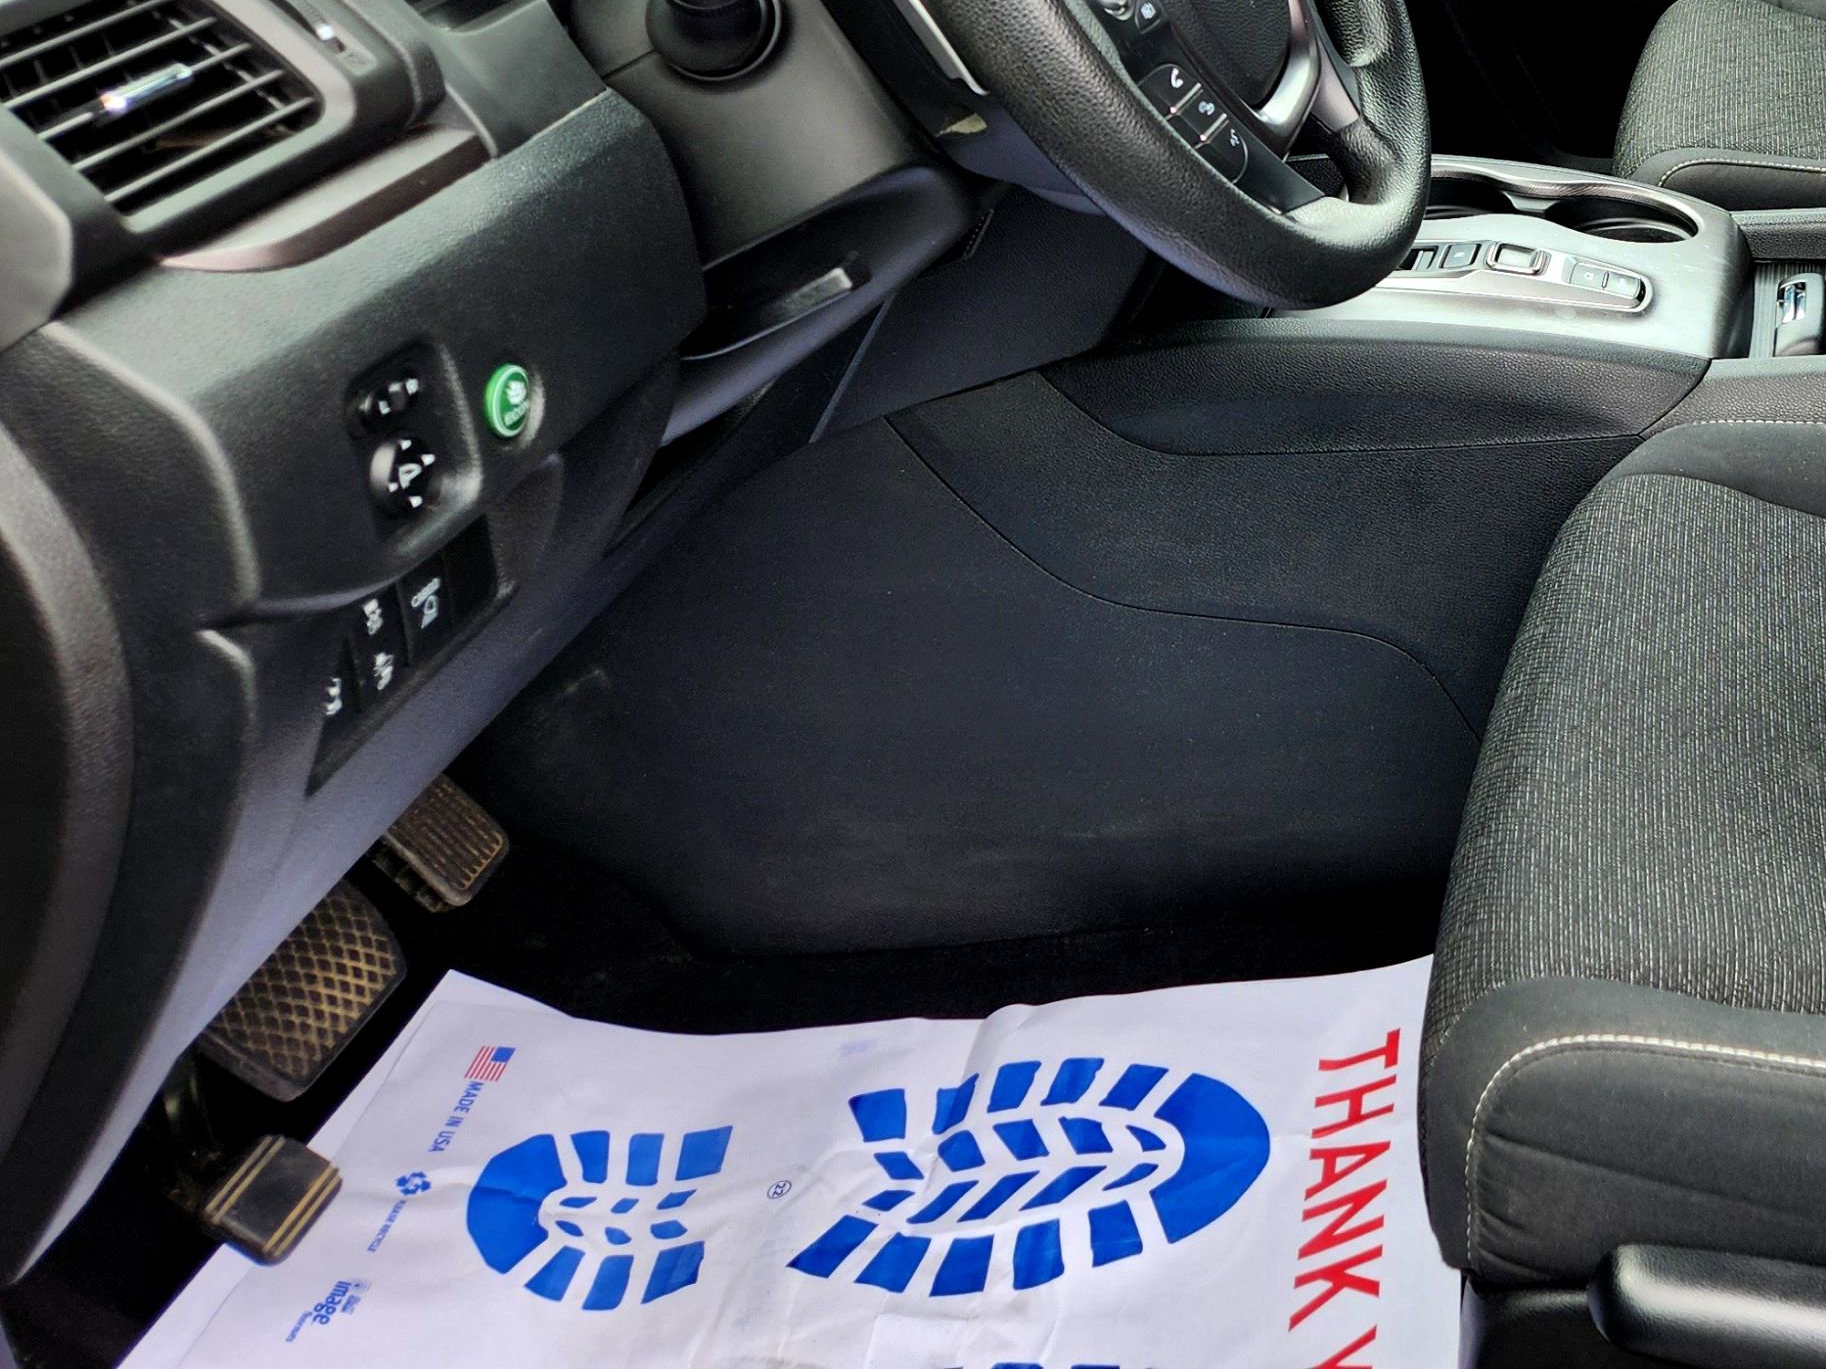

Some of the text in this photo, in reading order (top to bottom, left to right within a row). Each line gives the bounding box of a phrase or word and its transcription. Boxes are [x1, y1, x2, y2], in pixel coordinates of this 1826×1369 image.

[428, 1080, 485, 1152] MADE IN USA
[1288, 1028, 1401, 1333] THANK
[312, 1280, 361, 1325] image
